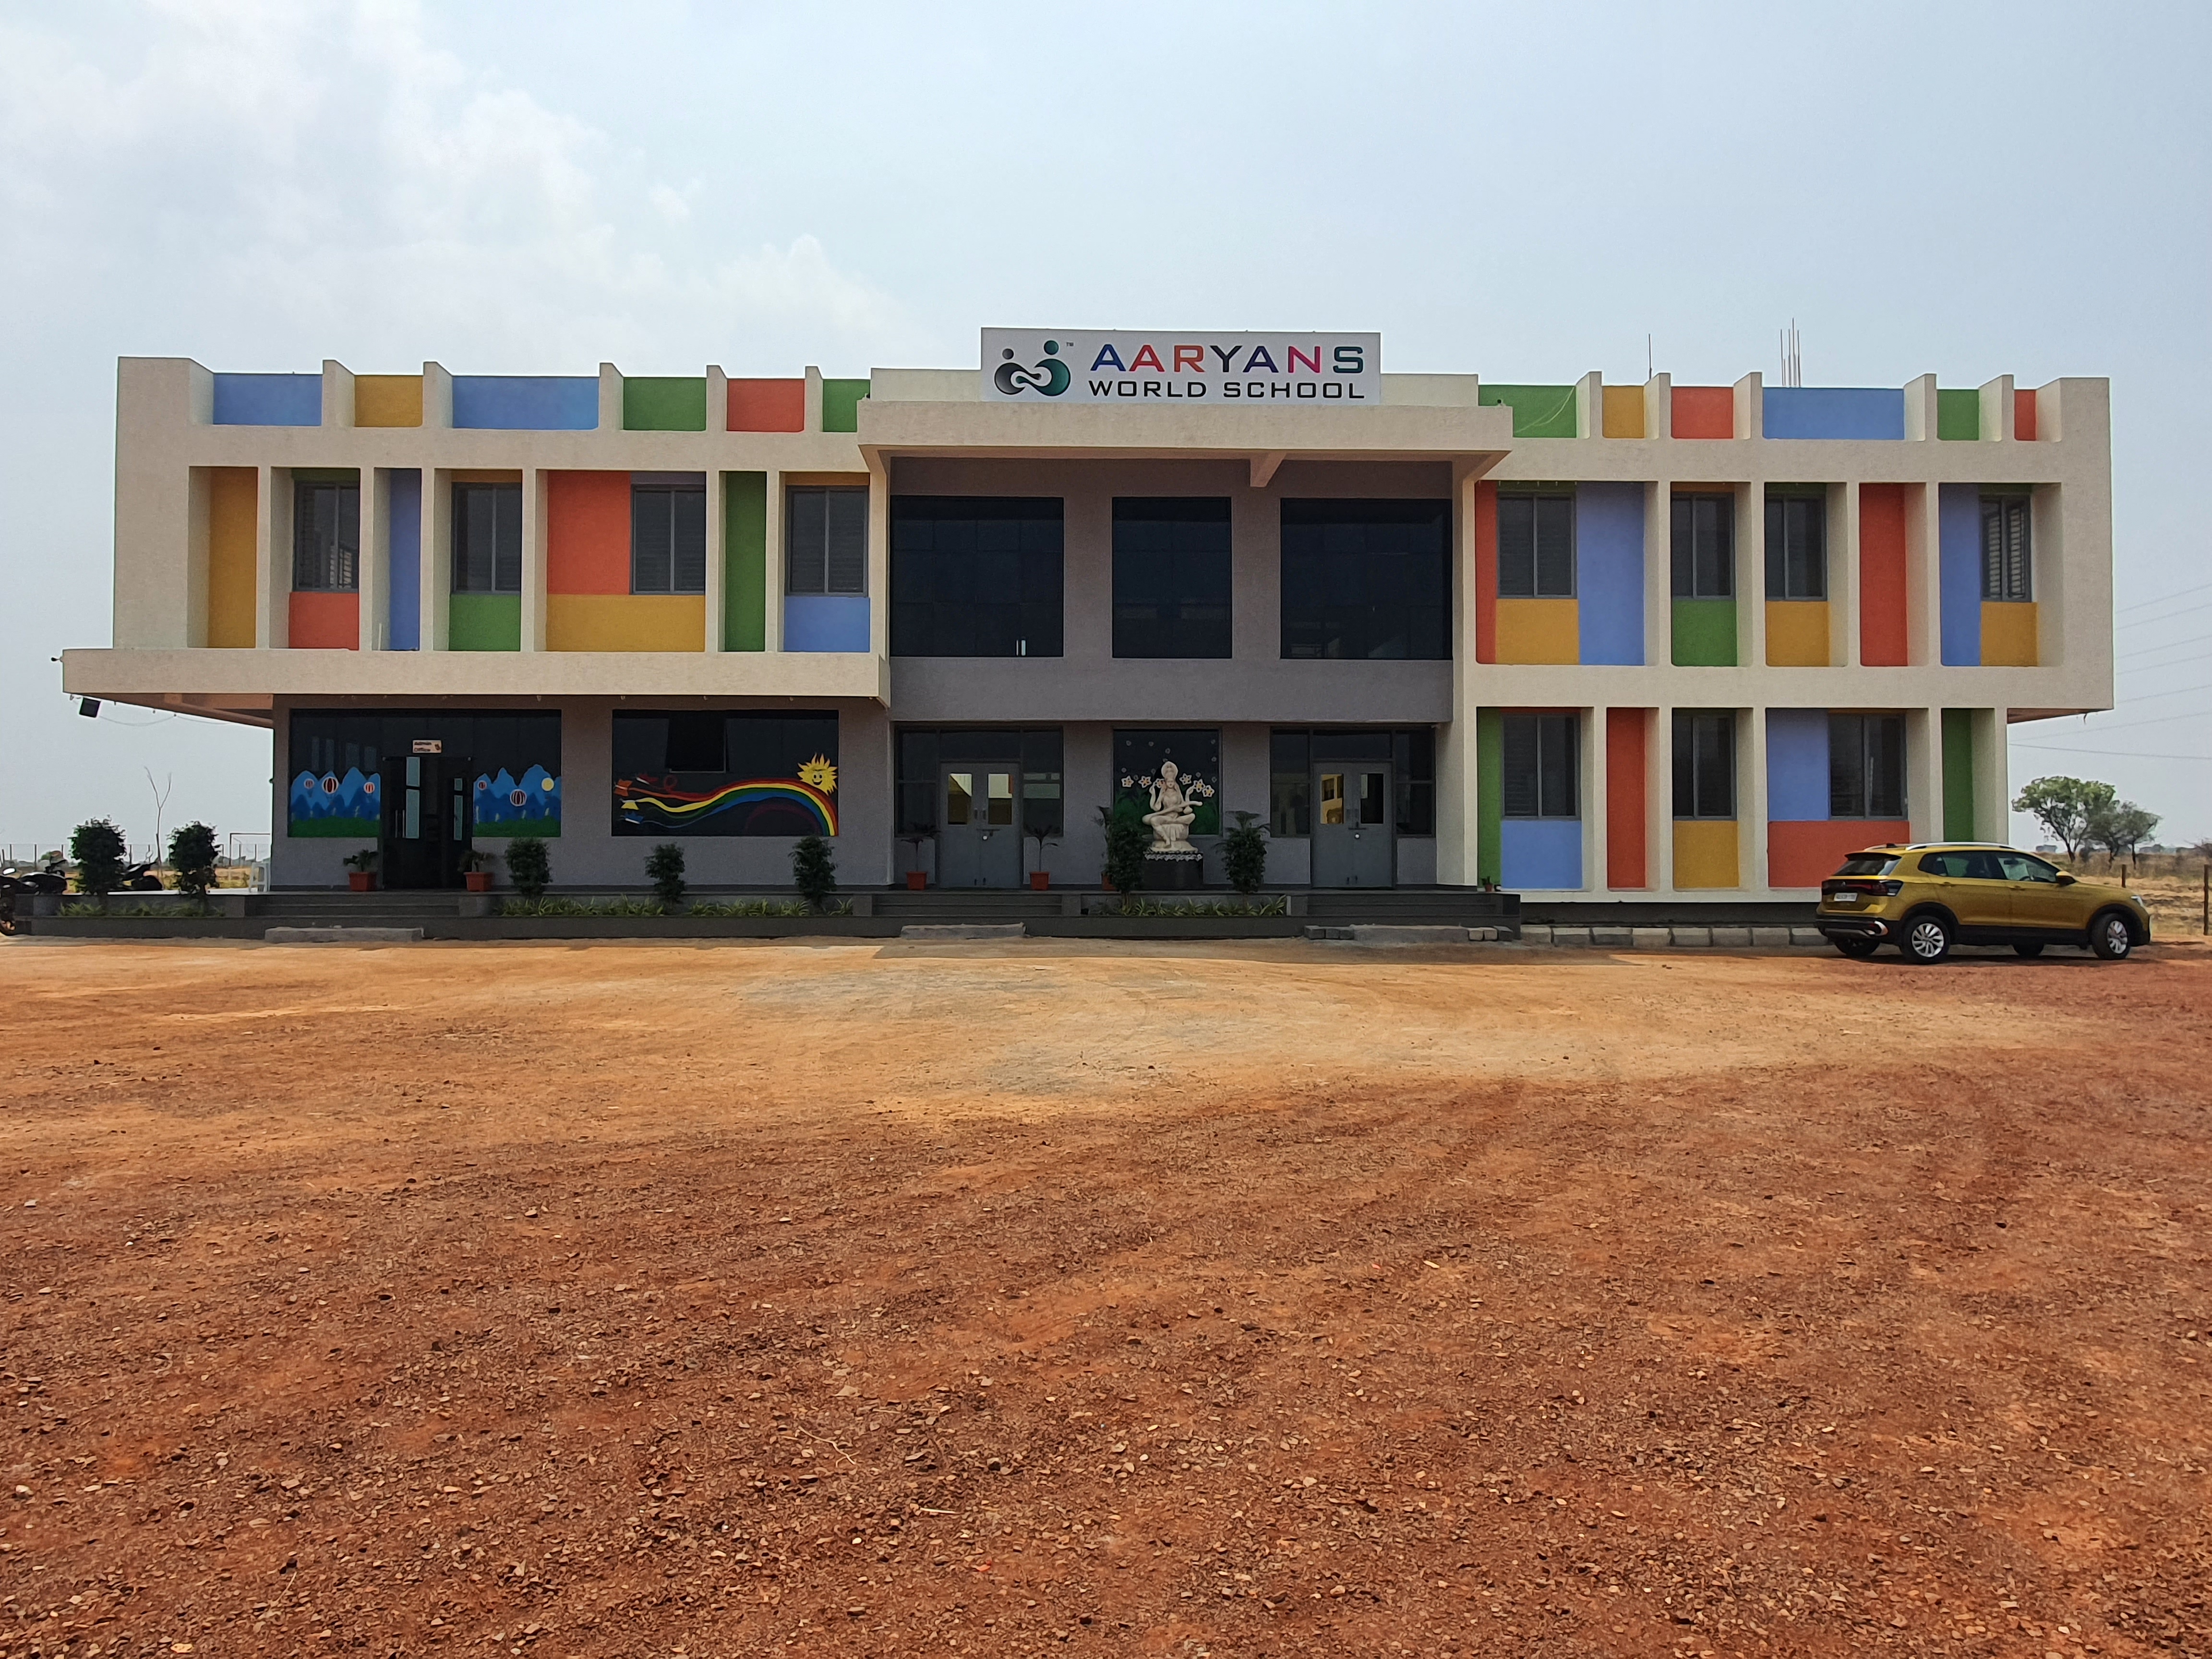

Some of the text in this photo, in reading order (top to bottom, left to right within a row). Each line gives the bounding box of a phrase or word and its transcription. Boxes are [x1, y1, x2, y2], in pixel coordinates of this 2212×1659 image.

[1091, 344, 1364, 374] AARYANS
[1089, 381, 1365, 399] WORLD SCHOOL
